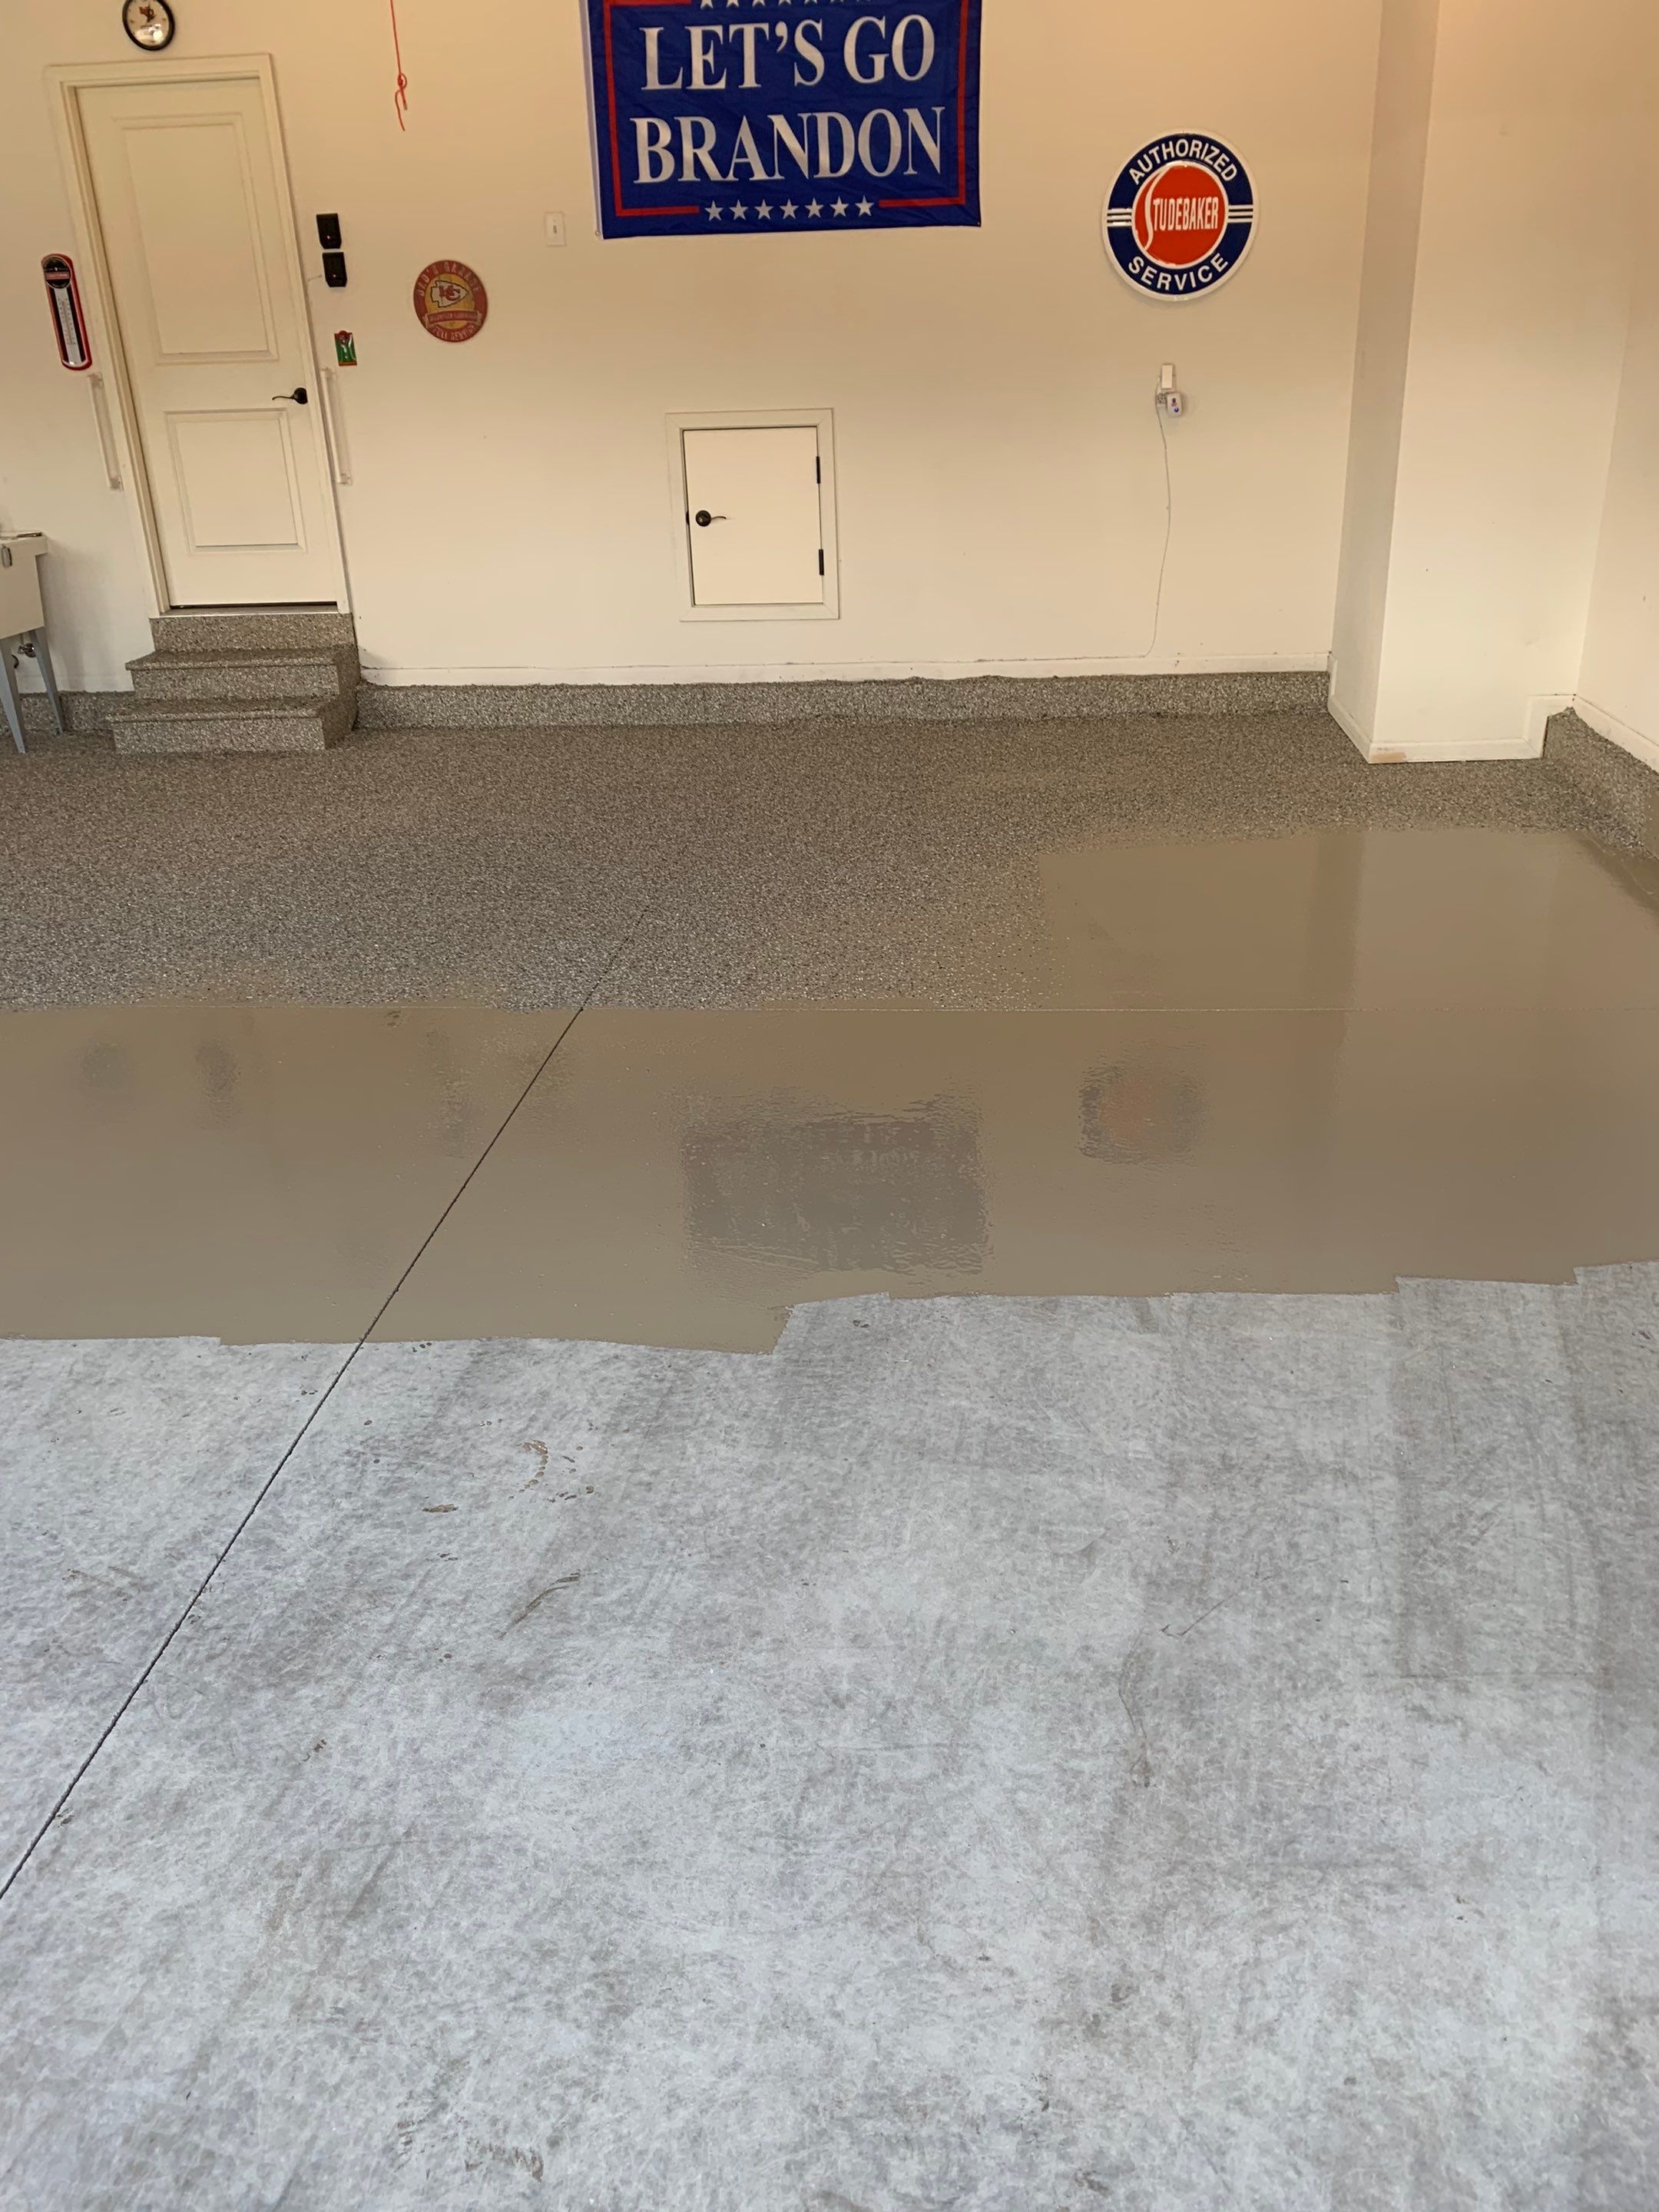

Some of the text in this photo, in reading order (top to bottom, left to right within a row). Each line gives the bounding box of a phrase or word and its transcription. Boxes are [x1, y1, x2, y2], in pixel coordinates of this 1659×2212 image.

[641, 14, 935, 90] LET'S GO
[630, 107, 945, 184] BRANDON
[1128, 138, 1237, 185] AUTHORIZED
[1128, 253, 1229, 291] SERVICE
